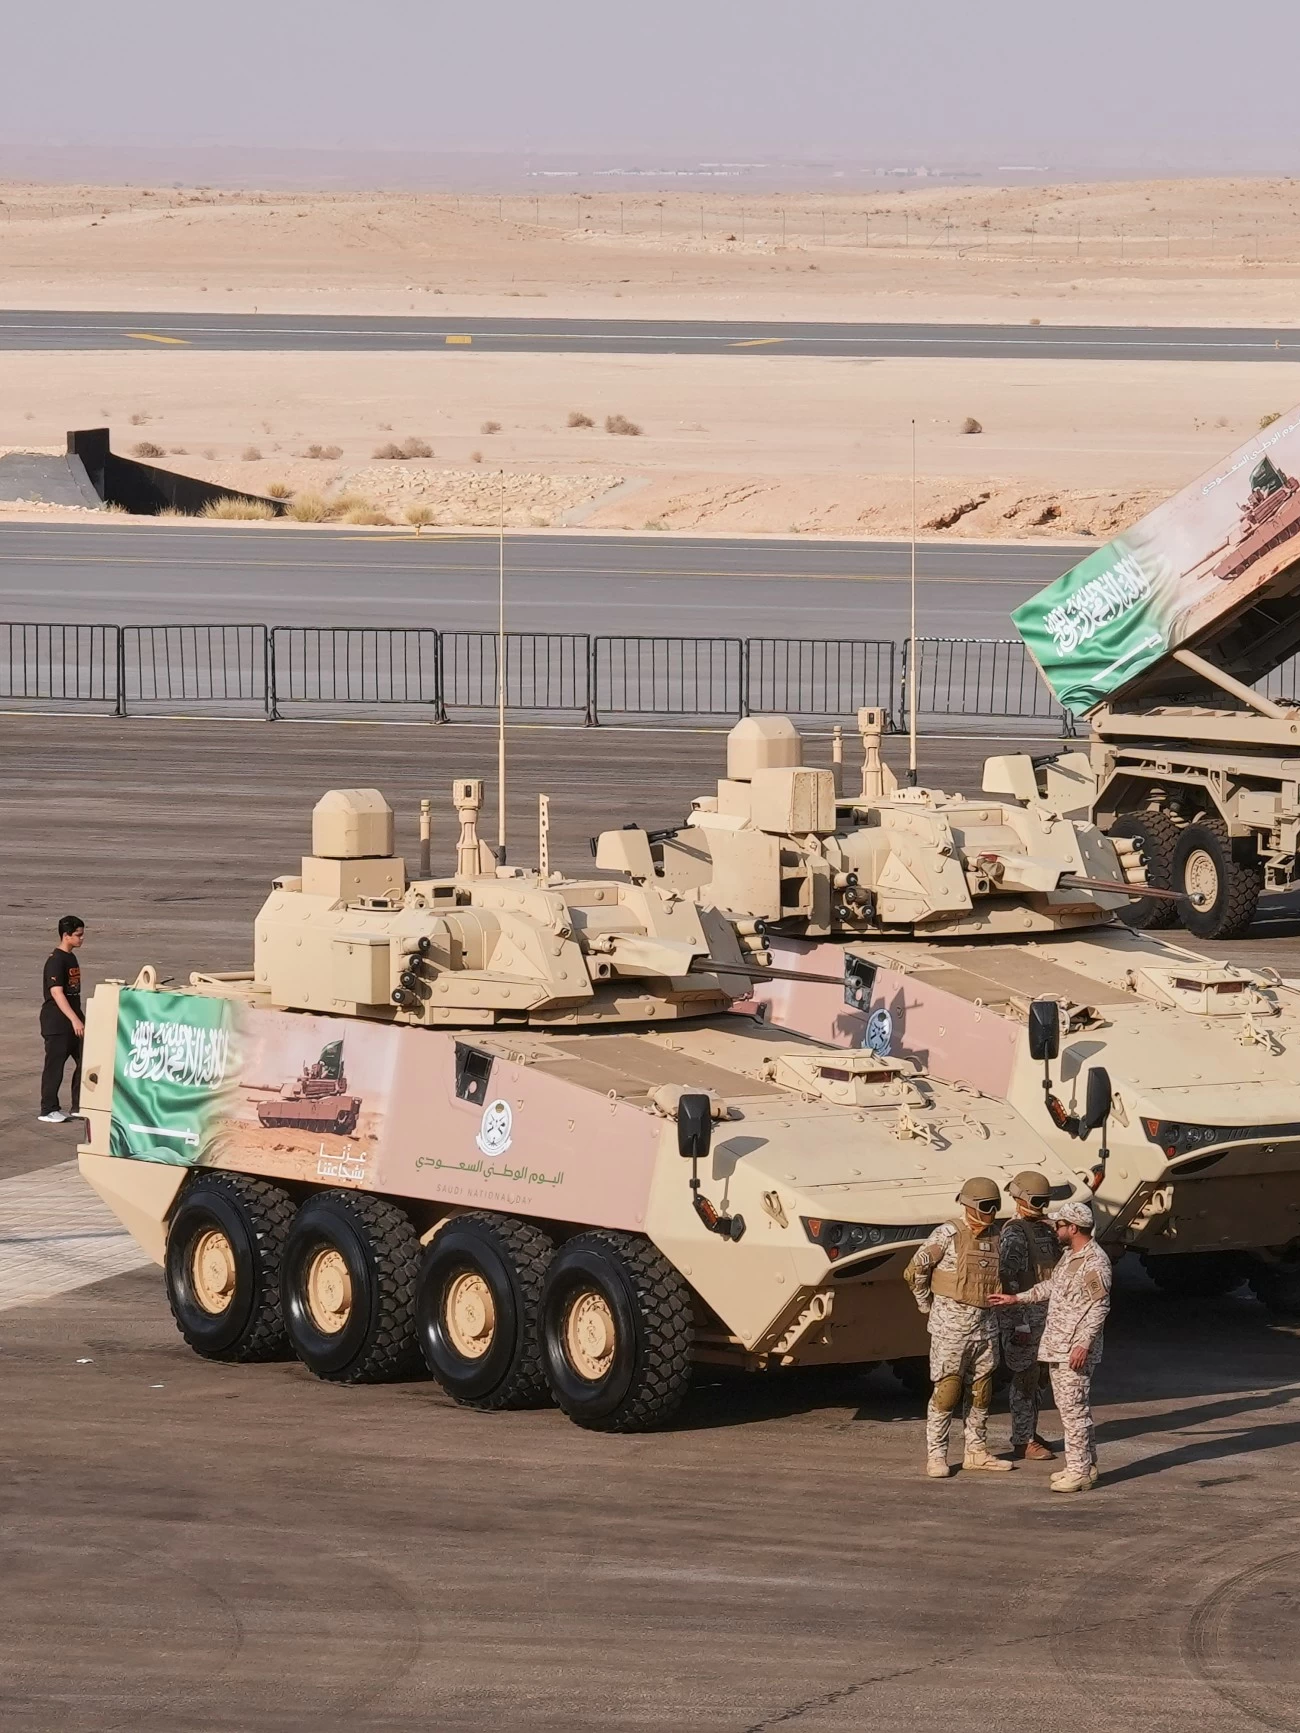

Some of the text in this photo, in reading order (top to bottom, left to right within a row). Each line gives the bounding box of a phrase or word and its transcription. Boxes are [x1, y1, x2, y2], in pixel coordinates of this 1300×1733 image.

[415, 1156, 565, 1188] اليوم الوطني السعودي
[436, 1183, 532, 1205] SAUDI NATIONAL DAY
